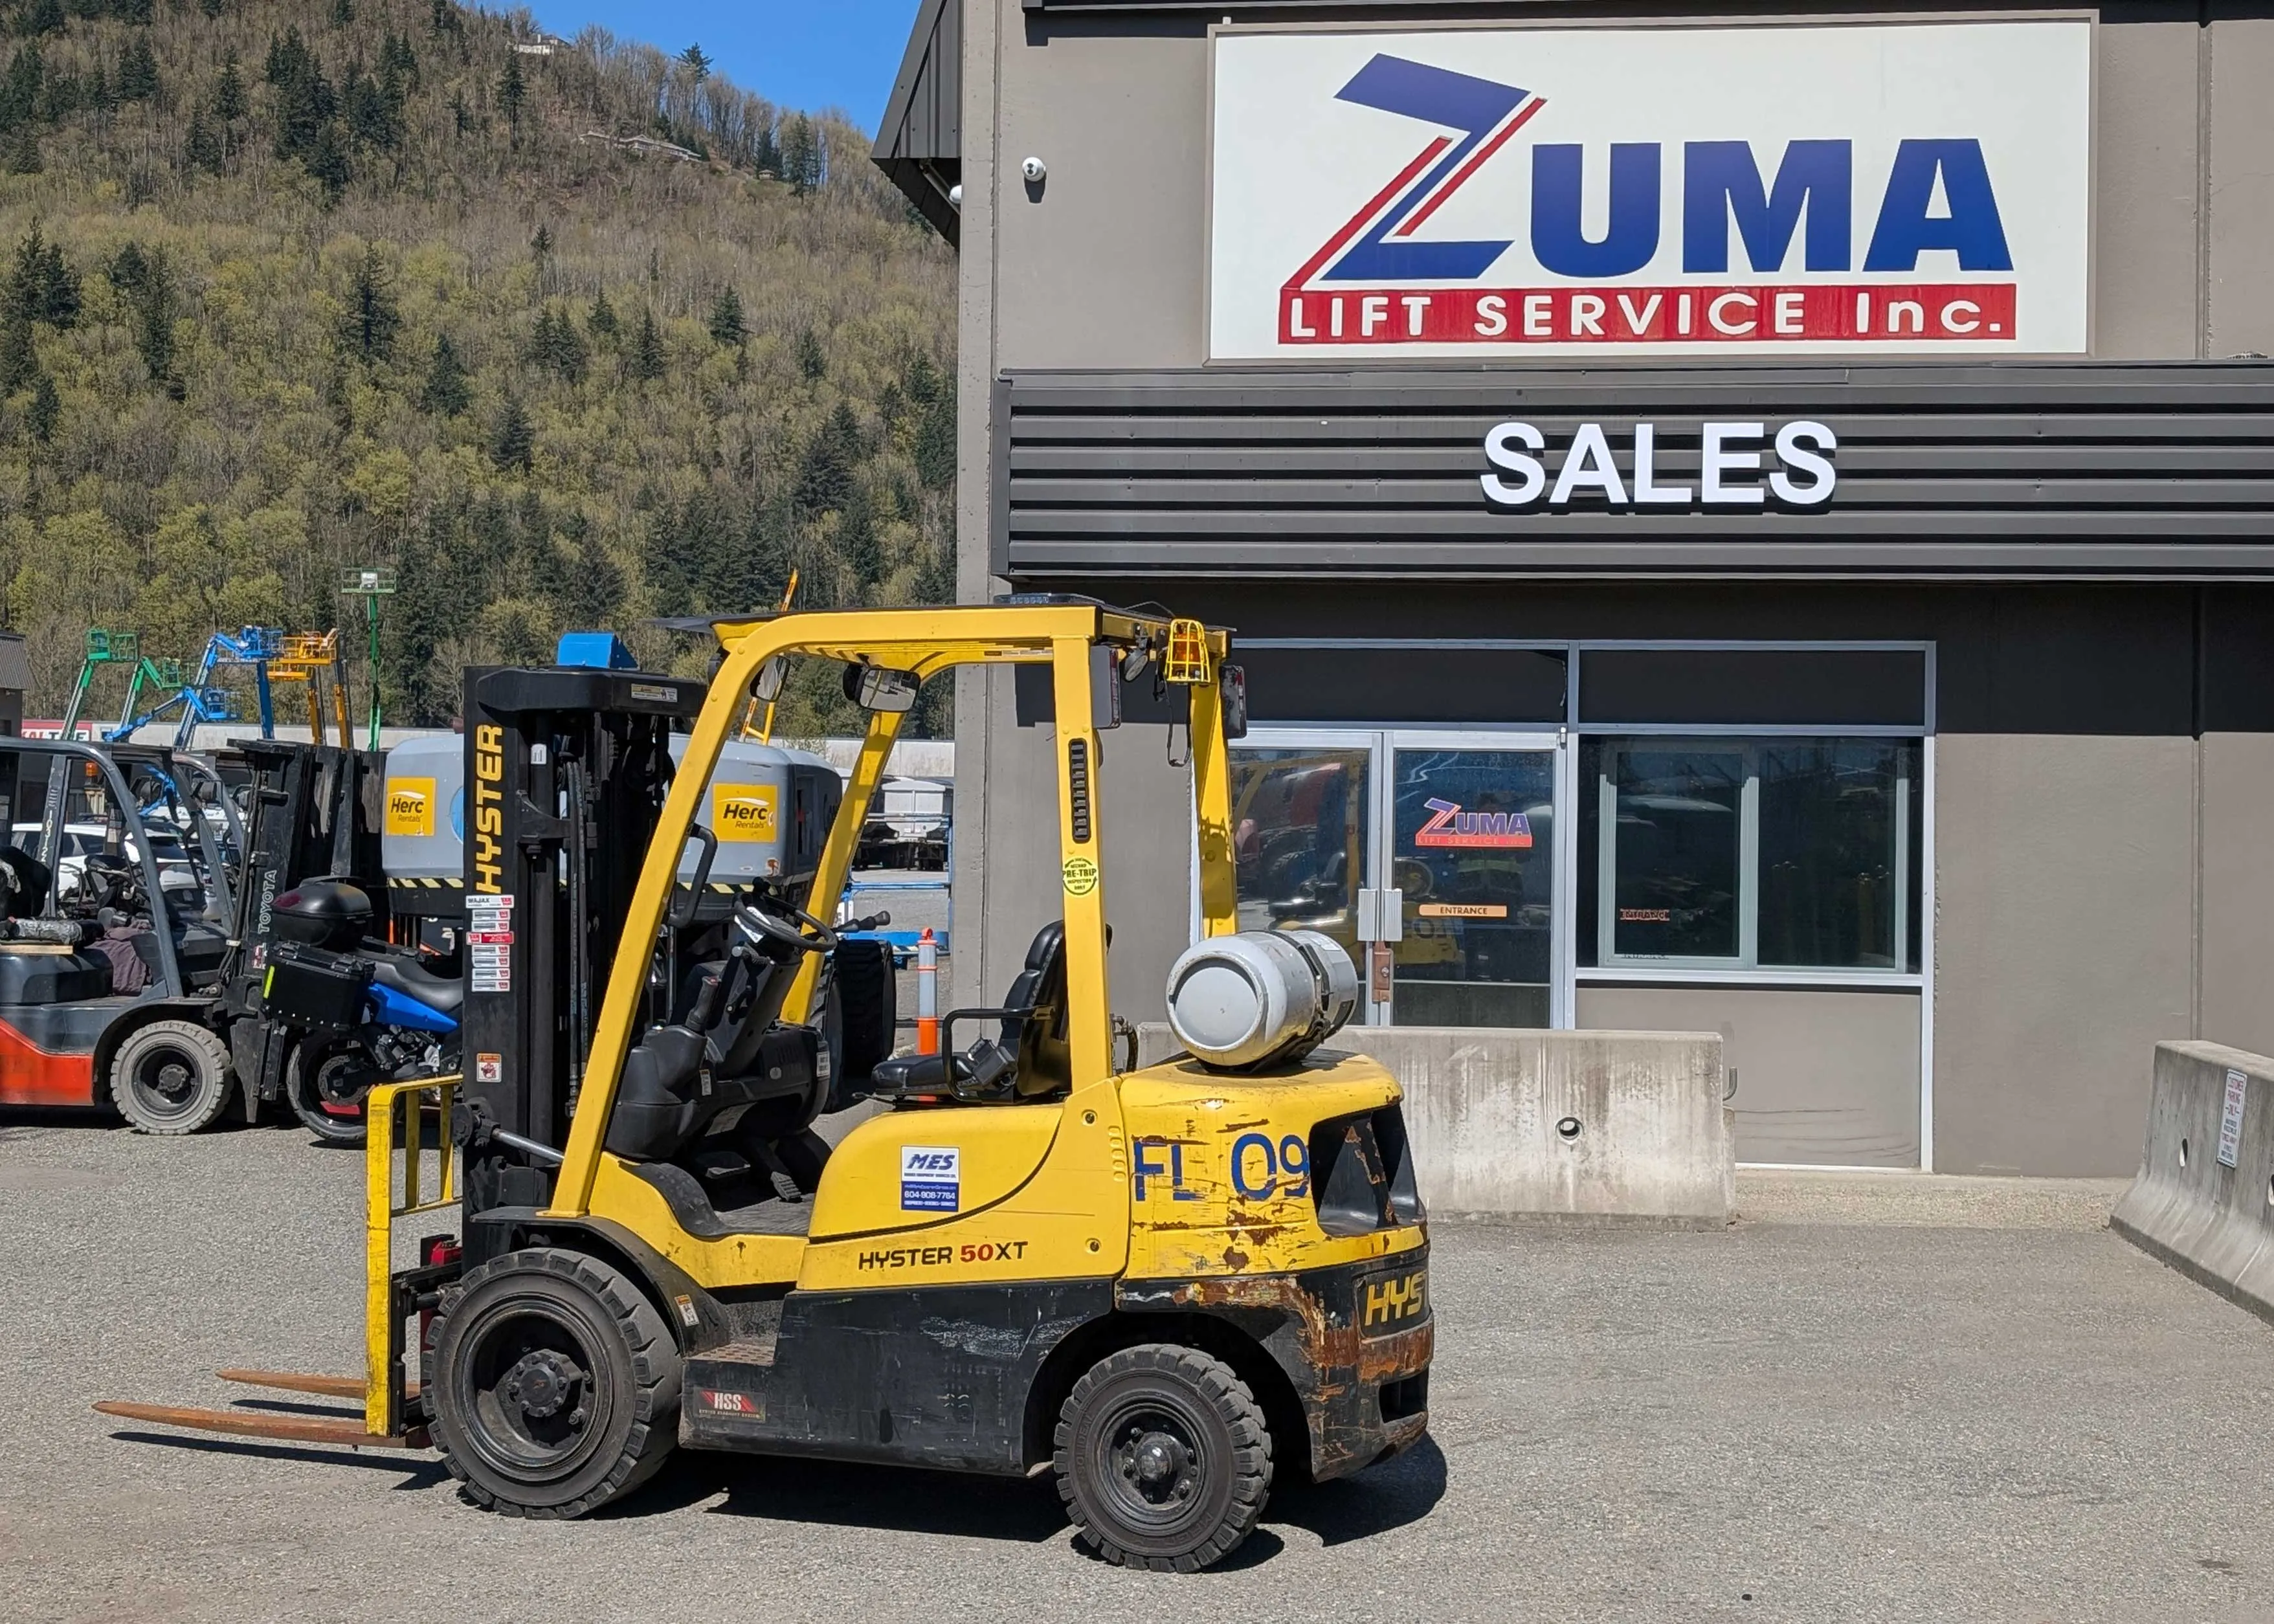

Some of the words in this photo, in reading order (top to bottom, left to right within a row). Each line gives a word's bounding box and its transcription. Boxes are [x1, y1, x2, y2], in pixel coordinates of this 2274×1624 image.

[1314, 52, 2014, 278] ZUMA
[1290, 295, 1433, 339] LIFT
[1473, 291, 1806, 338] SERVICE
[1856, 291, 2004, 337] Inc.
[1480, 421, 1838, 505] SALES
[390, 797, 424, 814] Herc
[476, 724, 503, 895] HYSTER
[722, 803, 768, 820] Herc
[1420, 797, 1532, 836] ZUMA
[735, 820, 764, 829] Rentals
[1447, 836, 1500, 845] SERVICE
[1062, 868, 1097, 878] PRE-TRIP
[258, 869, 278, 934] TOYOTA
[1440, 907, 1488, 915] ENTRANCE
[906, 1153, 956, 1170] MES
[1231, 1133, 1310, 1202] 09
[858, 1246, 953, 1270] HYSTER
[960, 1241, 1029, 1263] 50XT
[713, 1392, 742, 1411] HSS
